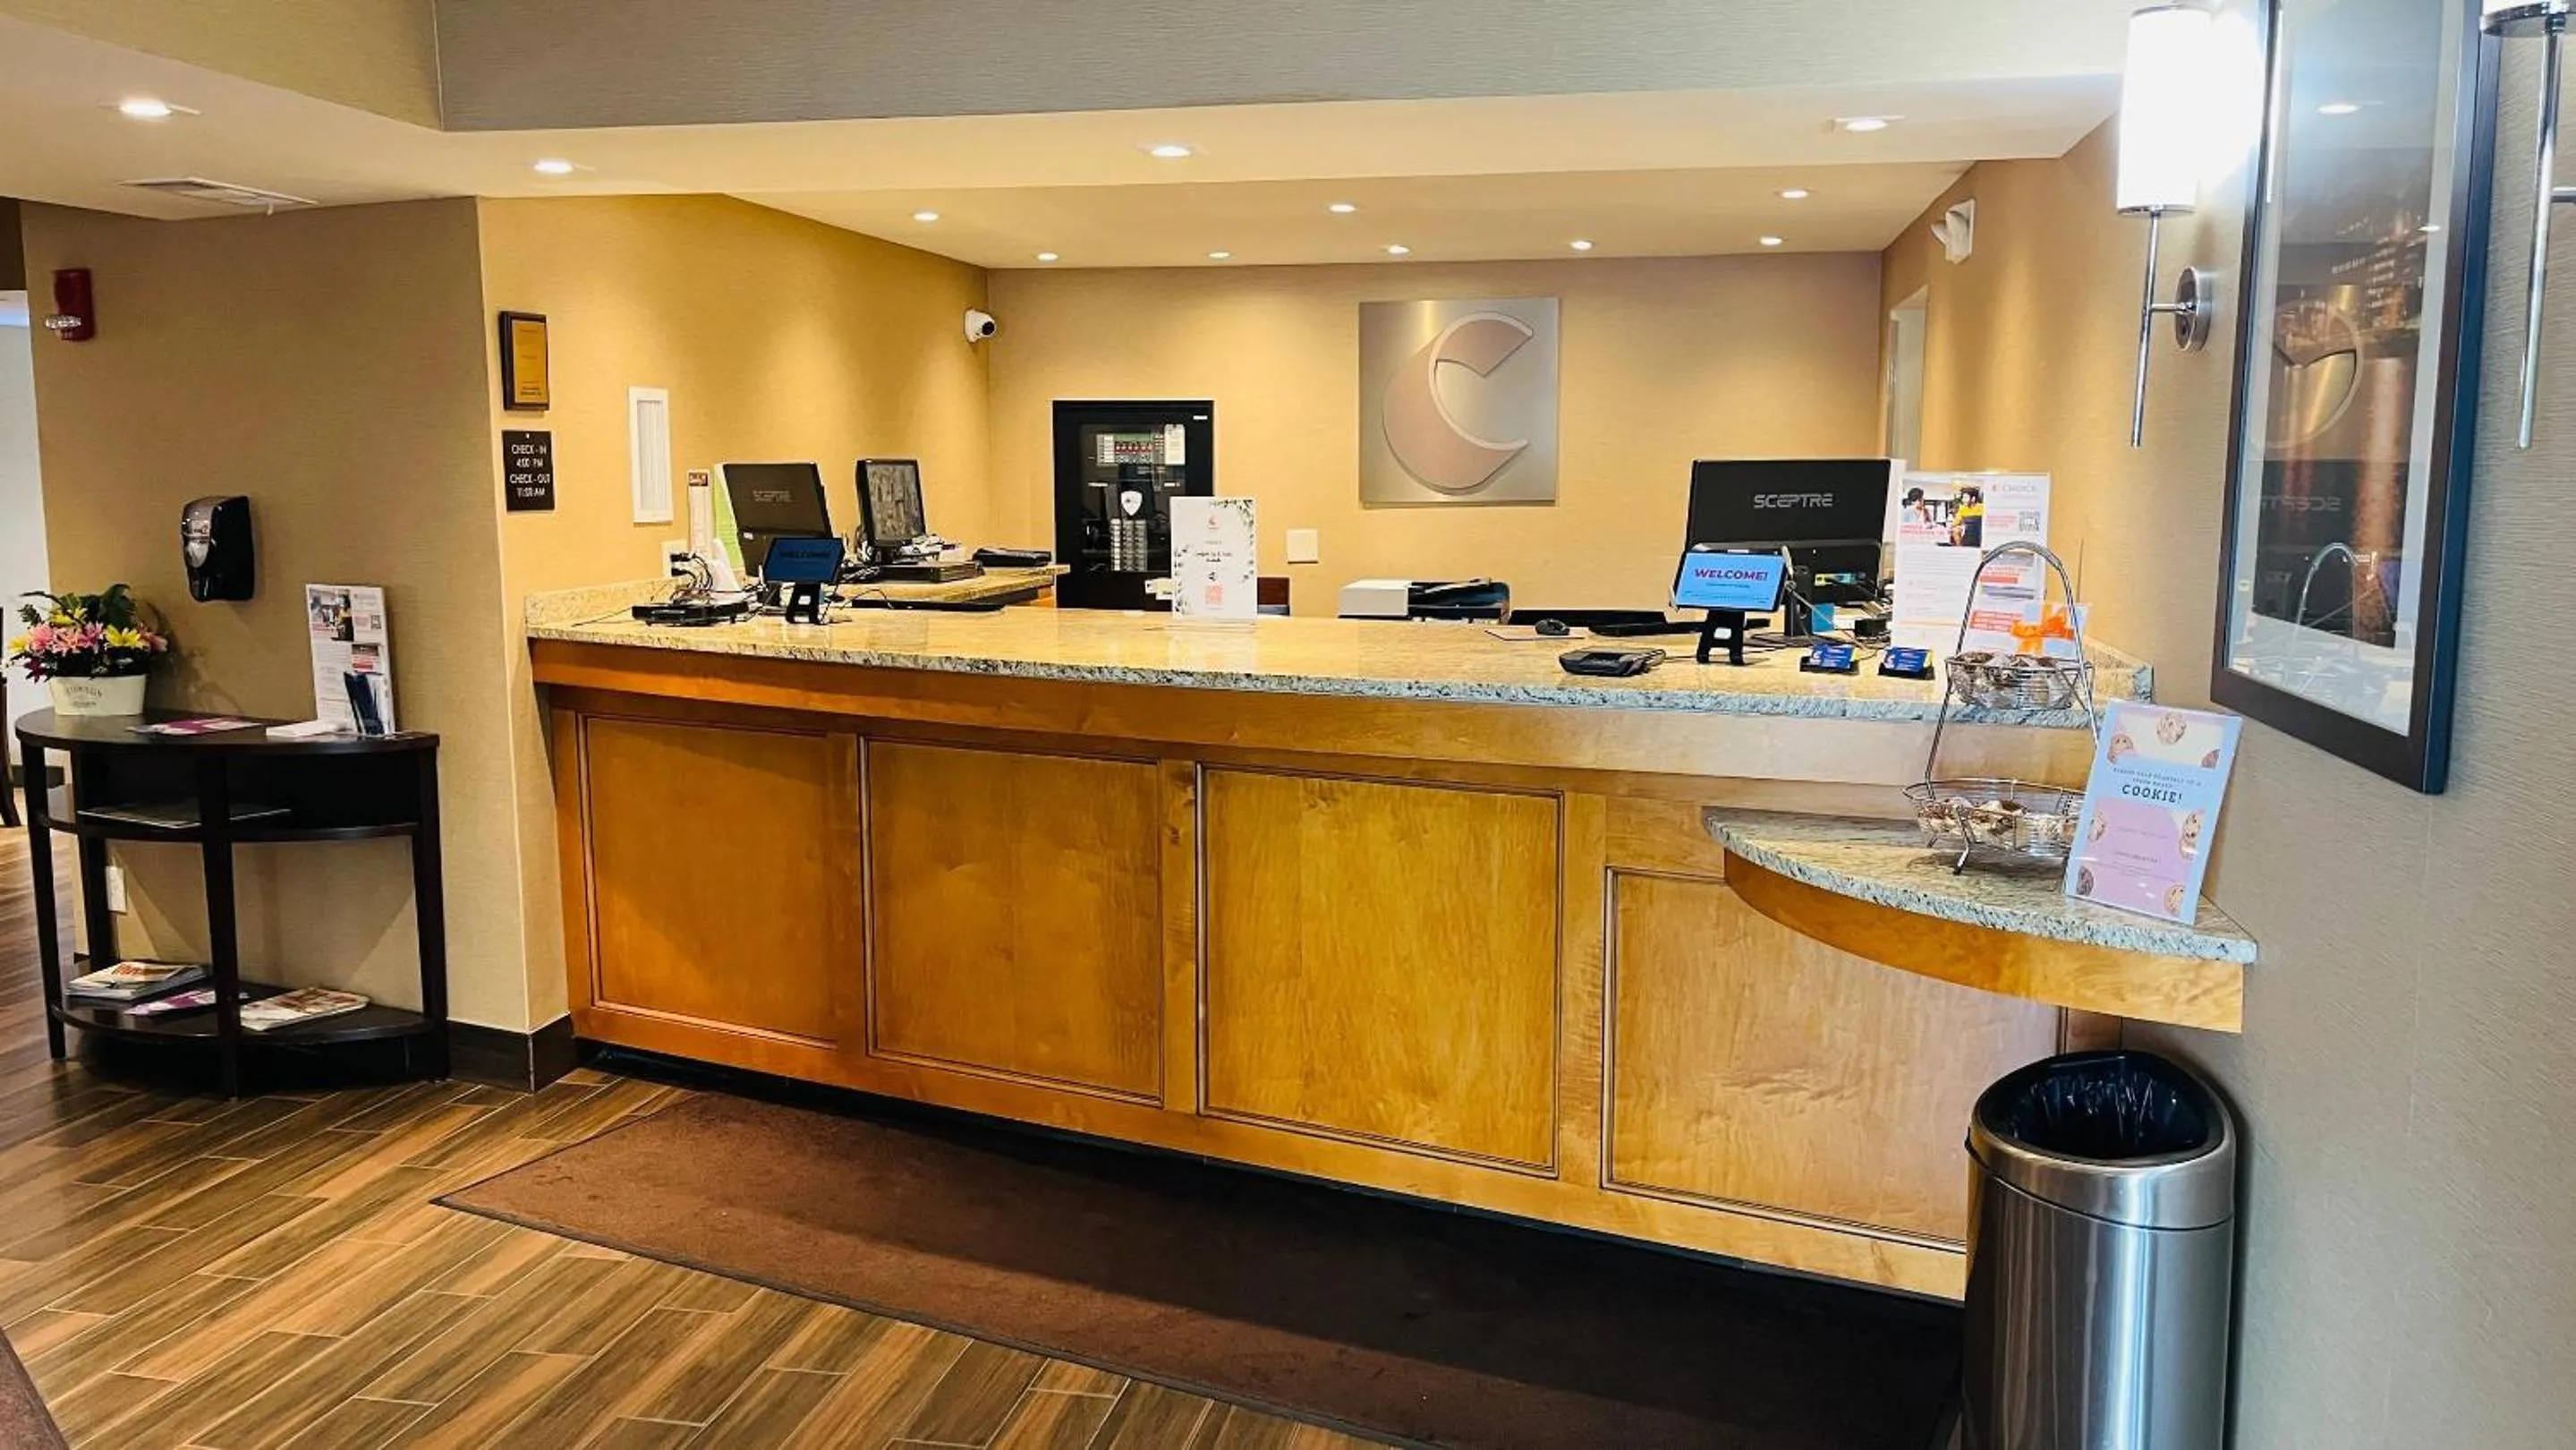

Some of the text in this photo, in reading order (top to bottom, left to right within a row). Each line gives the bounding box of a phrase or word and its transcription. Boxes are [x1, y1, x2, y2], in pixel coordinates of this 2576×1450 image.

[511, 444, 534, 455] CHECK
[539, 444, 548, 455] IN
[532, 457, 543, 467] PM
[509, 473, 533, 483] CHECK
[537, 473, 550, 483] OUT
[534, 487, 545, 497] AM
[1754, 493, 1833, 508] SCEPTRE
[1695, 568, 1769, 581] WELCOME!
[2121, 784, 2182, 803] COOKIE!
